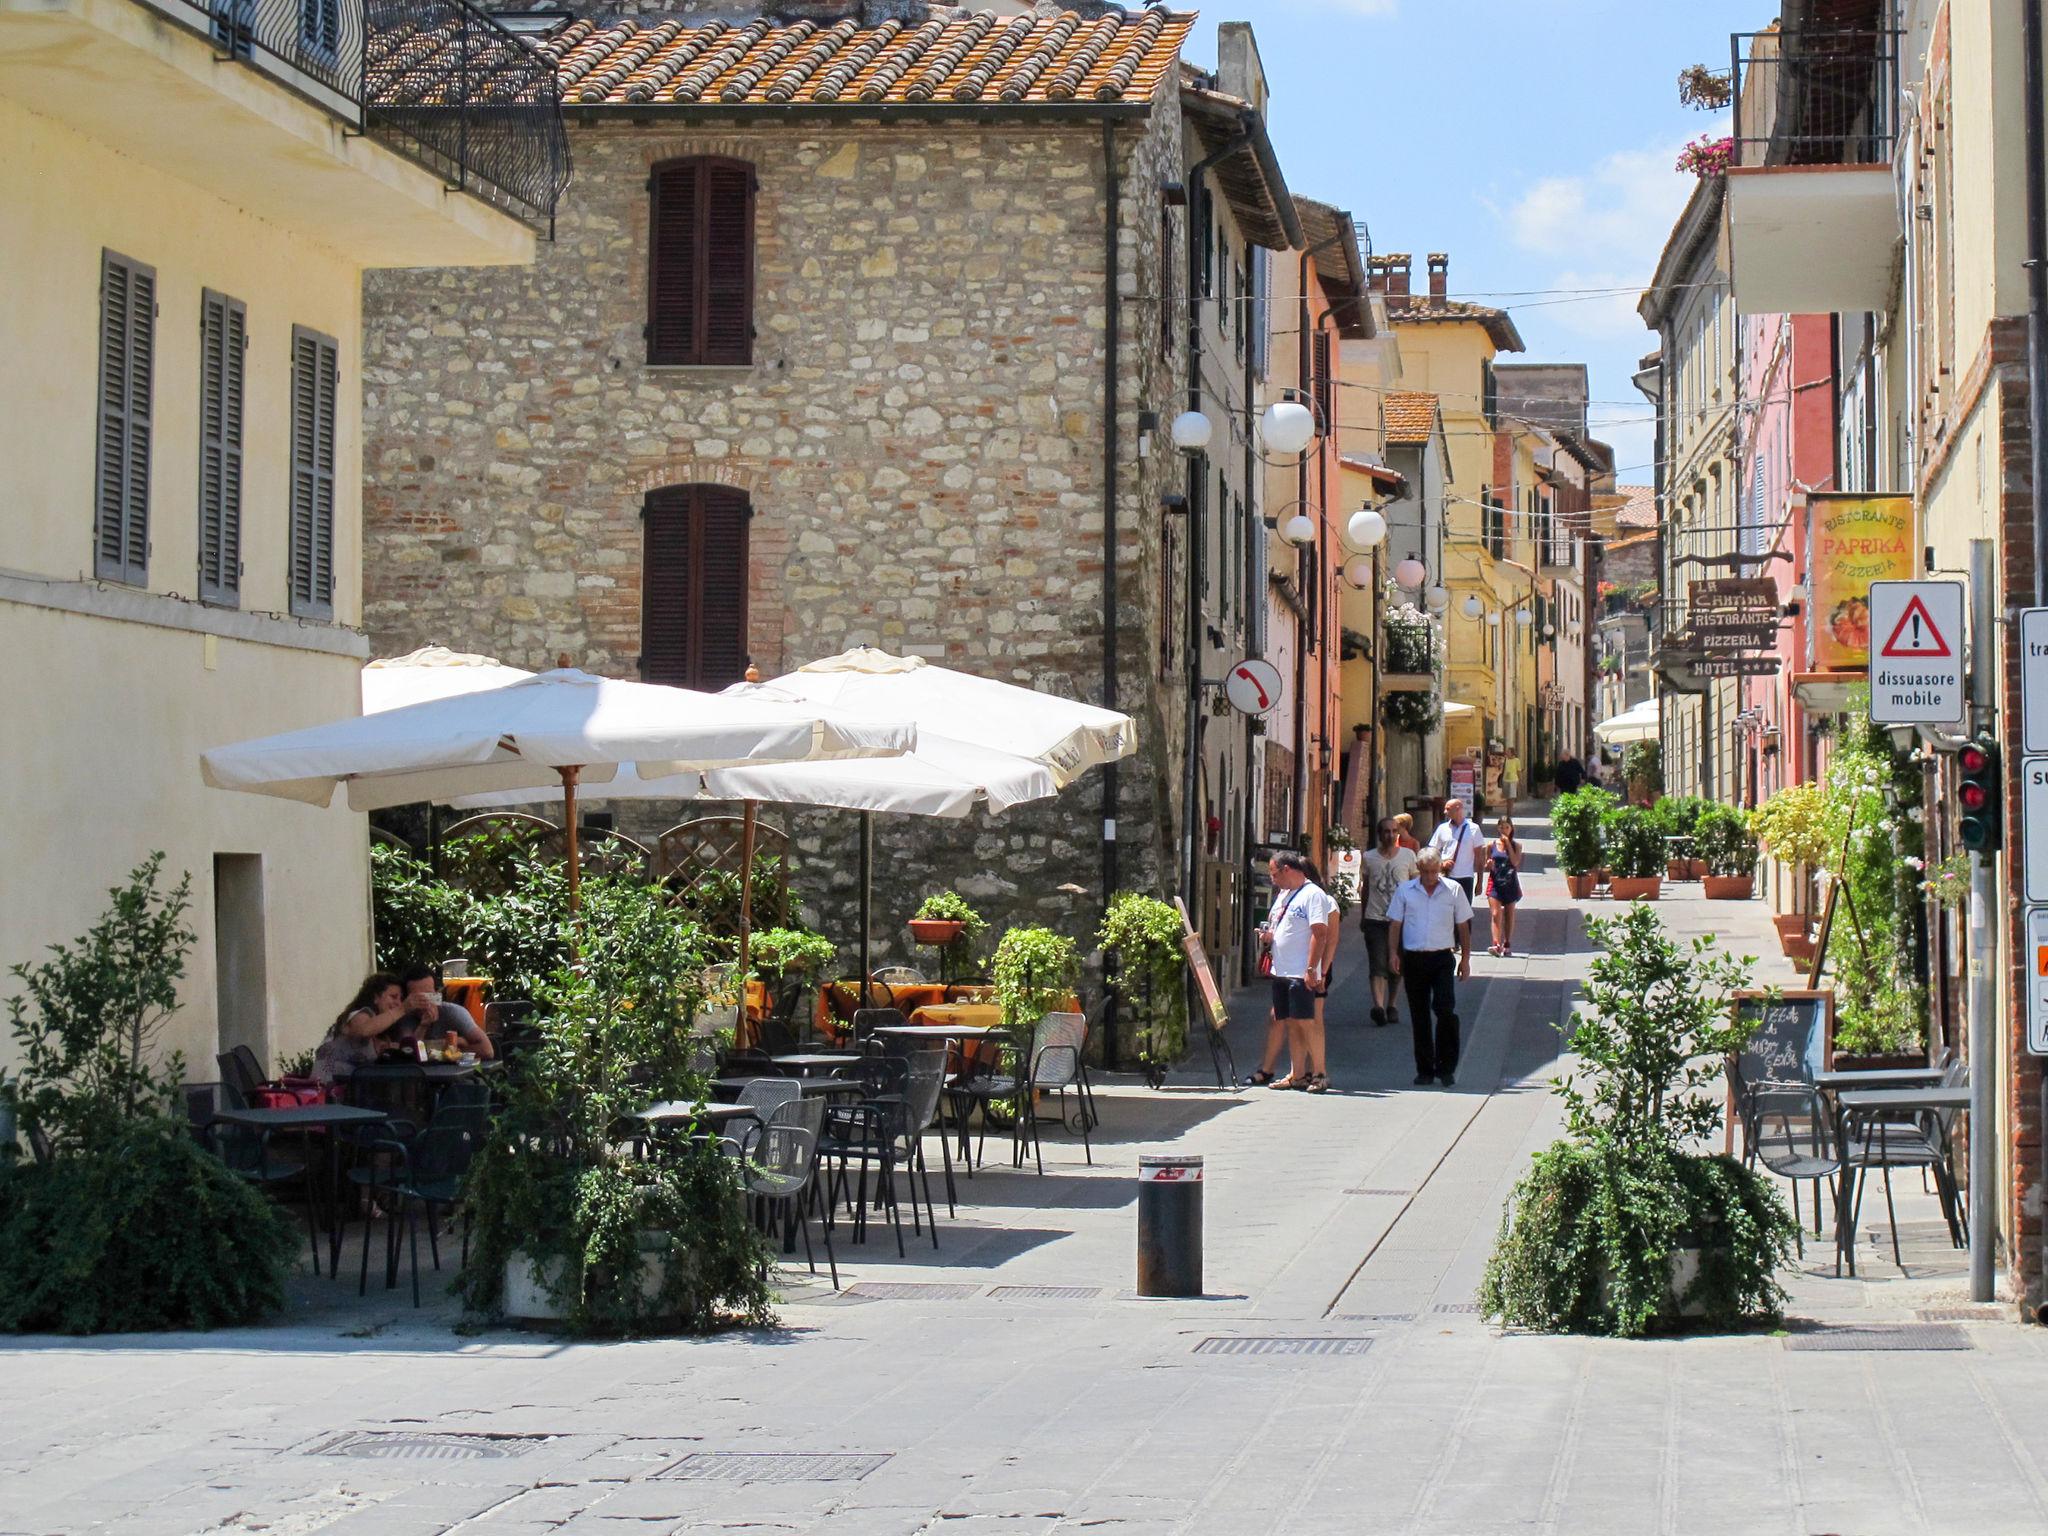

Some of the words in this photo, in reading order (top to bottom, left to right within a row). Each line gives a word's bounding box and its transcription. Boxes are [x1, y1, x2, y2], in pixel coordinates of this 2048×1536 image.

[1824, 510, 1906, 532] RISTORANTE
[1823, 537, 1906, 555] PAPRIKA
[1835, 559, 1897, 577] PIZZERIA
[1697, 581, 1718, 593] LA
[1695, 612, 1770, 626] RISTORANTE
[1704, 633, 1761, 647] PIZZERIA
[1694, 662, 1738, 676] HOTEL
[1878, 670, 1955, 686] dissuasore
[1891, 690, 1942, 706] mobile
